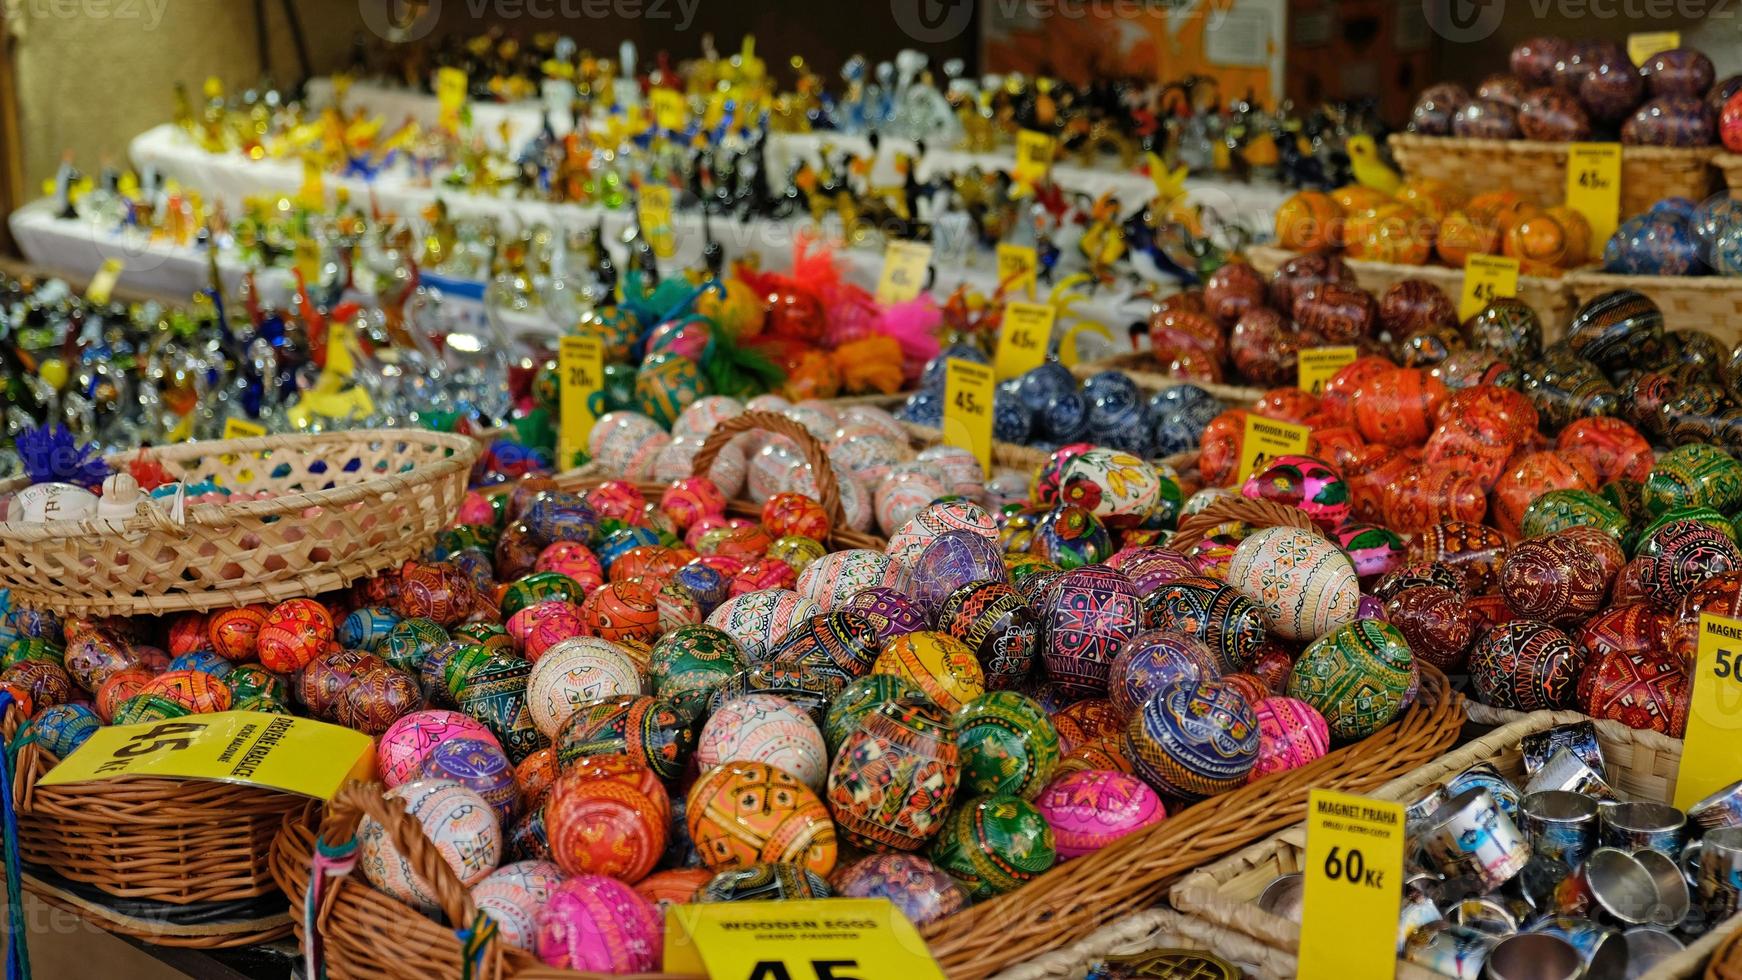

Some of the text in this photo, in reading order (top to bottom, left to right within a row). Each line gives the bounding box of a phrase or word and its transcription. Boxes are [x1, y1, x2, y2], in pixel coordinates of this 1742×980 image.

[232, 744, 272, 778] KRASLICE
[1318, 800, 1398, 825] MAGNET PRAHA
[720, 918, 878, 931] WOODEN EGGS
